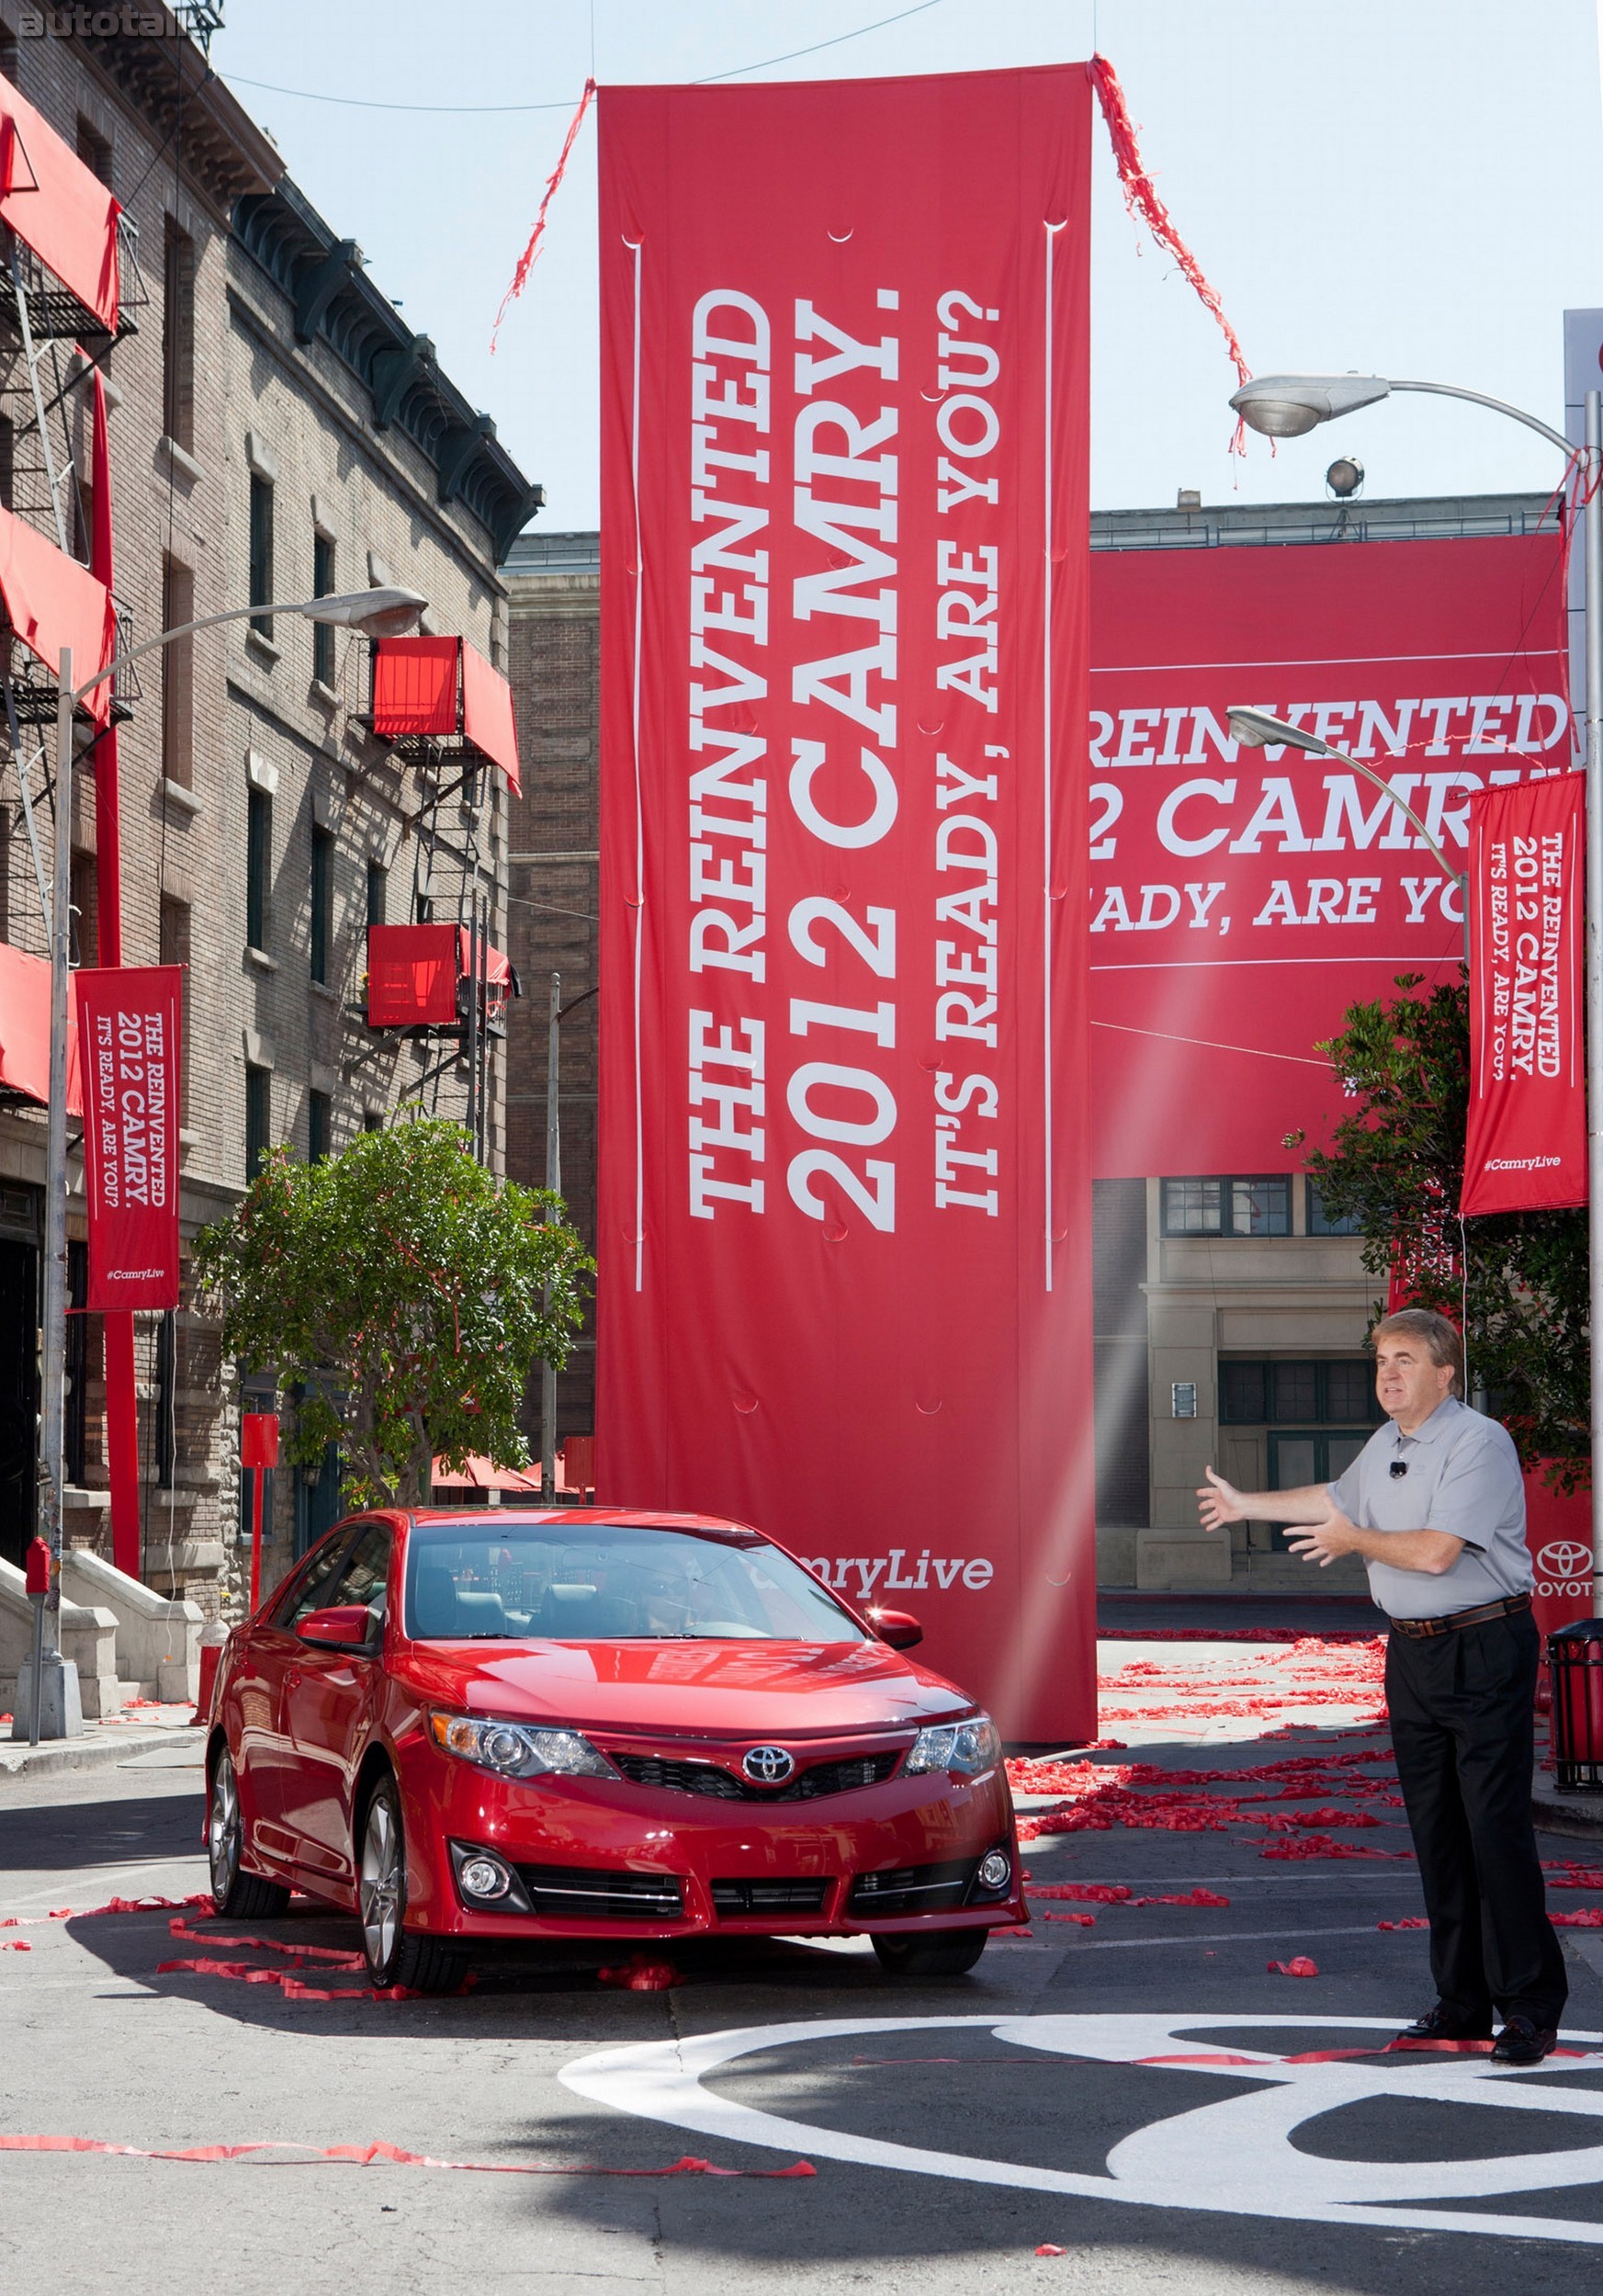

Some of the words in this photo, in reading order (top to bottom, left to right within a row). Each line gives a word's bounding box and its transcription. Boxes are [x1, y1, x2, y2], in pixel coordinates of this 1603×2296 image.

[936, 289, 1000, 515] YOU?
[789, 288, 899, 849] CAMRY.
[690, 289, 771, 984] REINVENTED
[936, 540, 999, 714] ARE
[1156, 769, 1561, 857] CAMR
[935, 744, 1010, 1048] READY,
[1490, 843, 1507, 879] IT'S
[1513, 835, 1539, 921] 2012
[1541, 832, 1563, 888] THE
[1090, 883, 1231, 935] ADY,
[1252, 879, 1381, 925] ARE
[1491, 885, 1509, 964] READY,
[1494, 971, 1510, 1017] ARE
[1510, 932, 1541, 1081] CAMRY.
[1537, 895, 1563, 1078] REINVENTED
[96, 1015, 112, 1046] IT'S
[118, 1011, 144, 1081] 2012
[144, 1012, 164, 1057] THE
[787, 897, 897, 1232] 2012
[1492, 1023, 1507, 1081] YOU?
[98, 1049, 116, 1114] READY,
[689, 1009, 766, 1220] THE
[101, 1118, 118, 1156] ARE
[120, 1090, 148, 1209] CAMRY.
[147, 1061, 165, 1208] REINVENTED
[934, 1071, 999, 1217] IT'S
[1484, 1156, 1562, 1171] #CamryLive
[103, 1159, 119, 1209] YOU?
[107, 1268, 164, 1281] #CamryLive
[1530, 1581, 1594, 1597] OYOT
